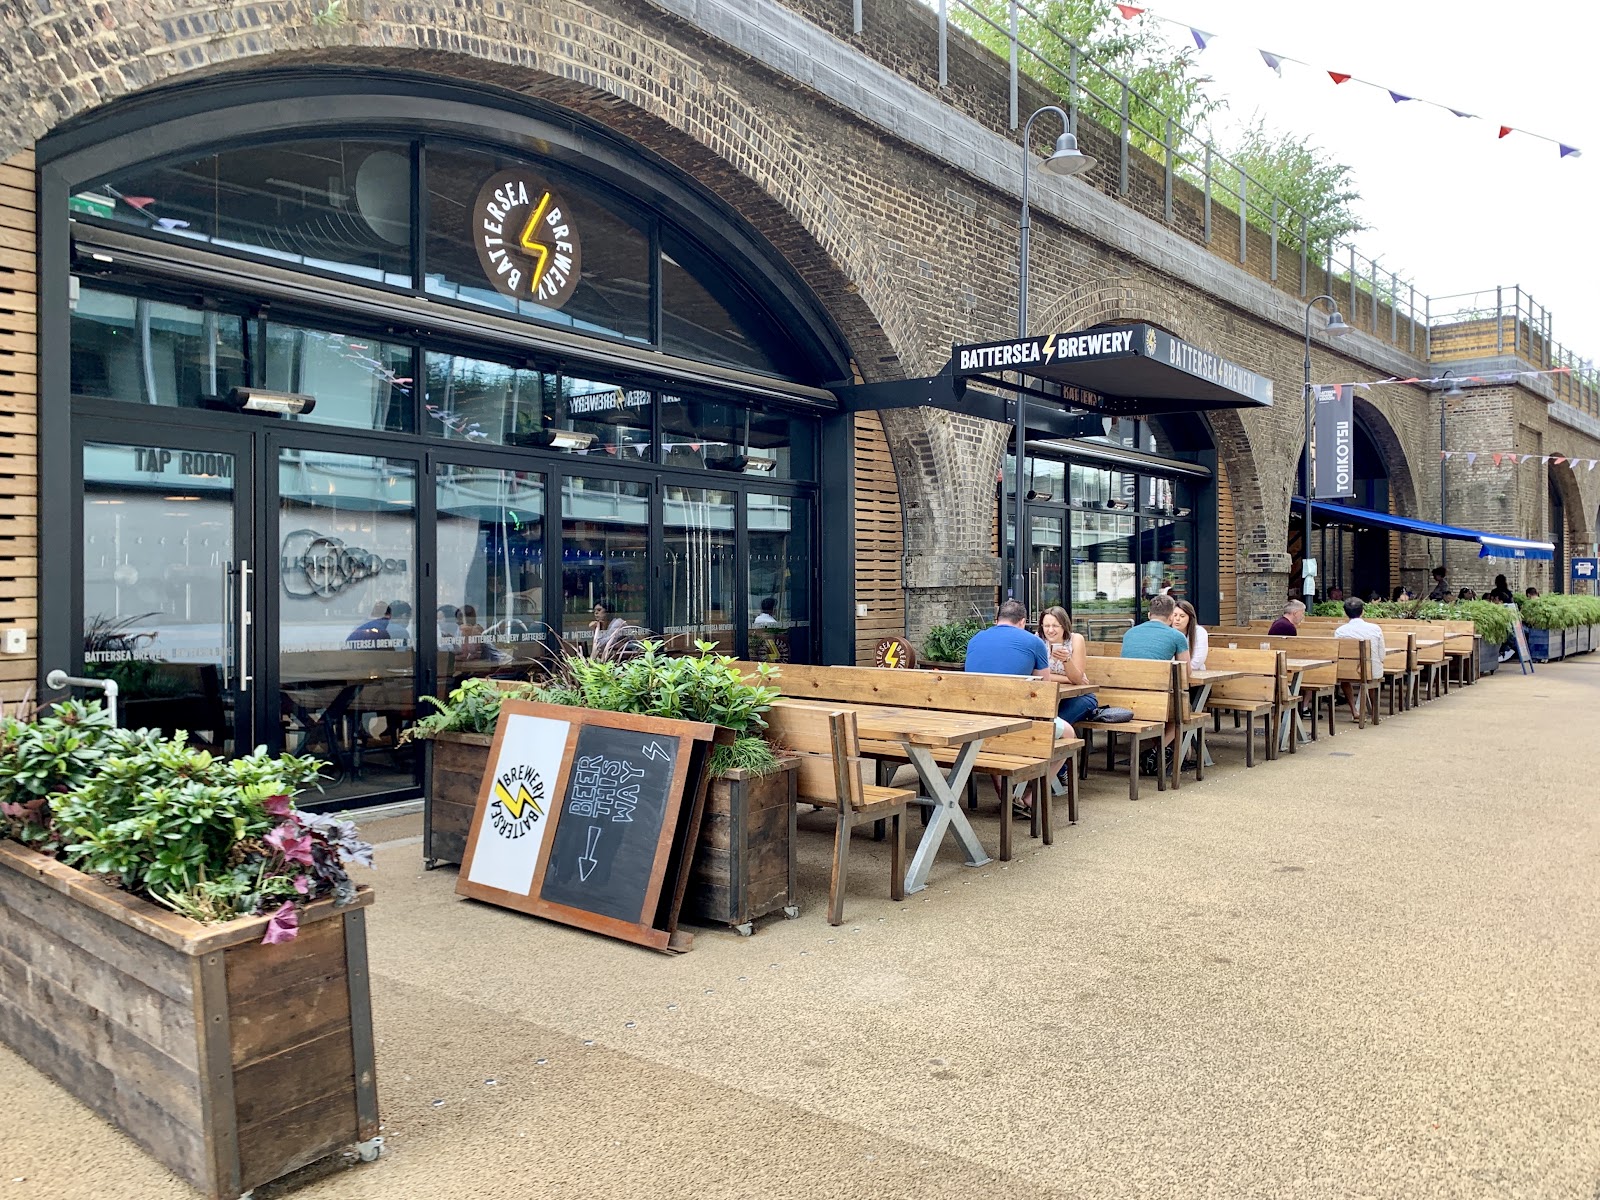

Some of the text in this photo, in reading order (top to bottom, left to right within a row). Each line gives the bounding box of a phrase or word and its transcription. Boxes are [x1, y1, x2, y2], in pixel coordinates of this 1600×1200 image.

[484, 181, 529, 291] BATTERSEA
[538, 207, 573, 300] BREWERY
[960, 341, 1040, 370] BATTERSEA
[1057, 330, 1133, 359] BREWERY
[1169, 338, 1218, 381] BATTERSEA
[1223, 362, 1256, 397] BREWERY
[134, 448, 232, 478] TAP ROOM
[1336, 421, 1349, 493] TONKOTSU
[84, 650, 132, 663] BATTERSEA
[377, 638, 404, 649] BREWERY
[502, 765, 545, 801] BREWERY
[568, 755, 603, 817] BEER
[592, 759, 621, 818] THIS
[611, 760, 645, 823] WAY
[491, 800, 540, 839] BATTERSEA
